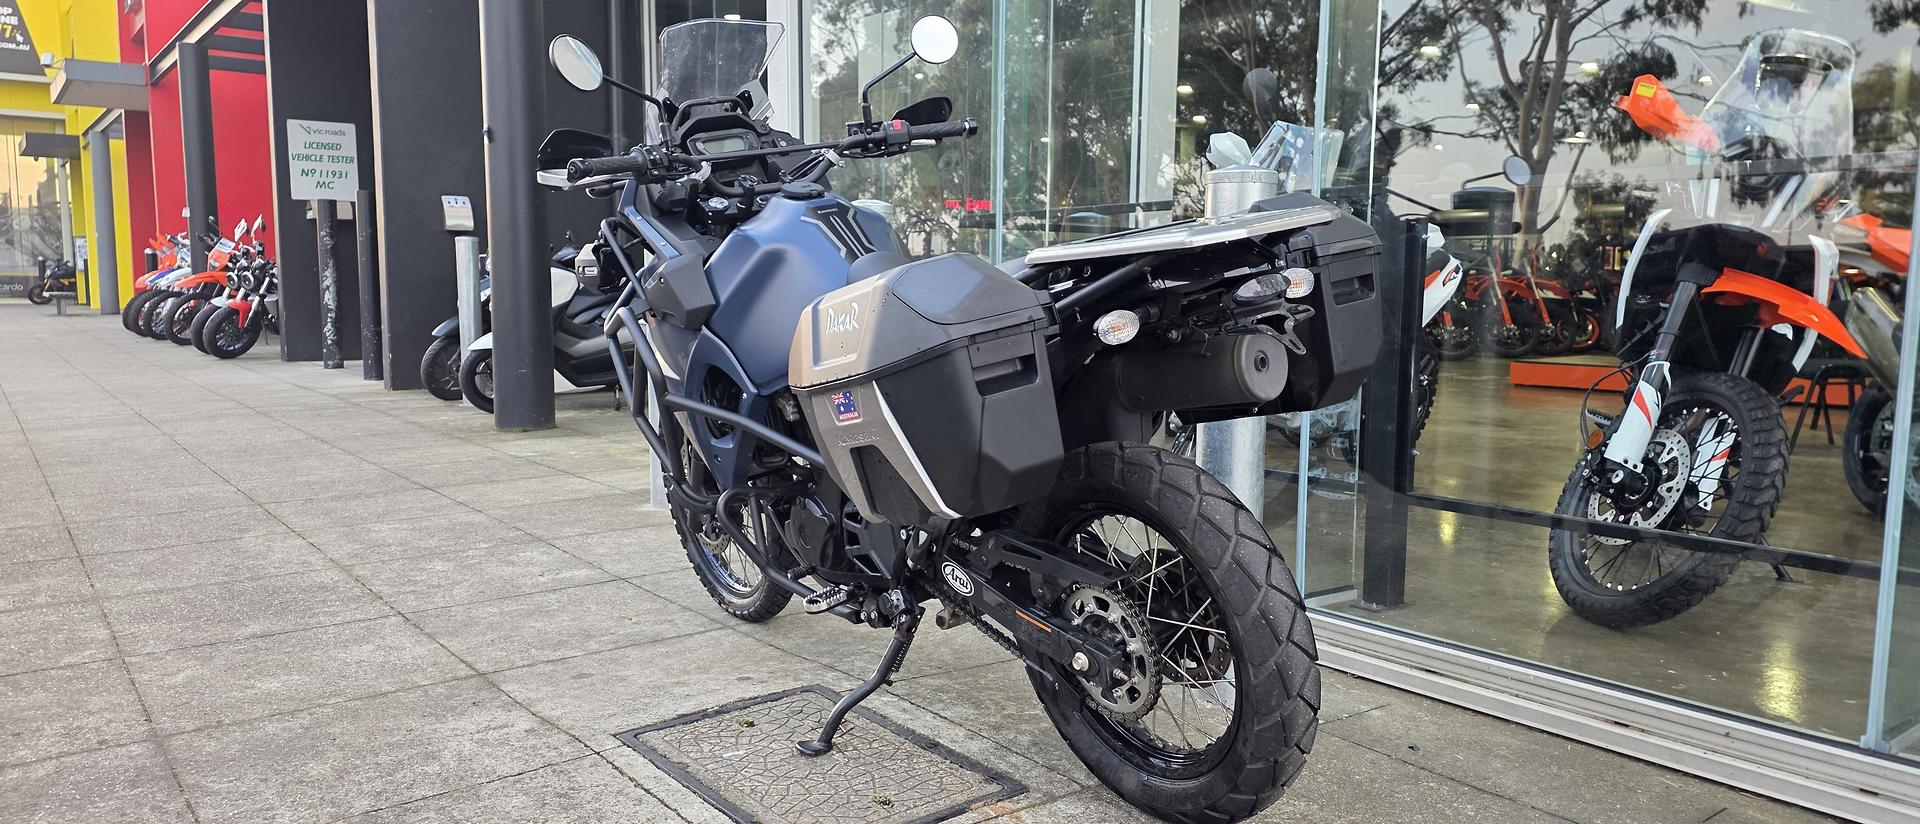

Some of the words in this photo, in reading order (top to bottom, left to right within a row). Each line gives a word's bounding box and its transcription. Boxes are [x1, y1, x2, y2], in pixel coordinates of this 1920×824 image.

[303, 141, 342, 151] LICENSED
[291, 153, 324, 162] VEHICLE
[327, 155, 355, 164] TESTER
[319, 169, 348, 179] 11931
[315, 180, 335, 190] MC
[825, 302, 859, 335] DAKAR
